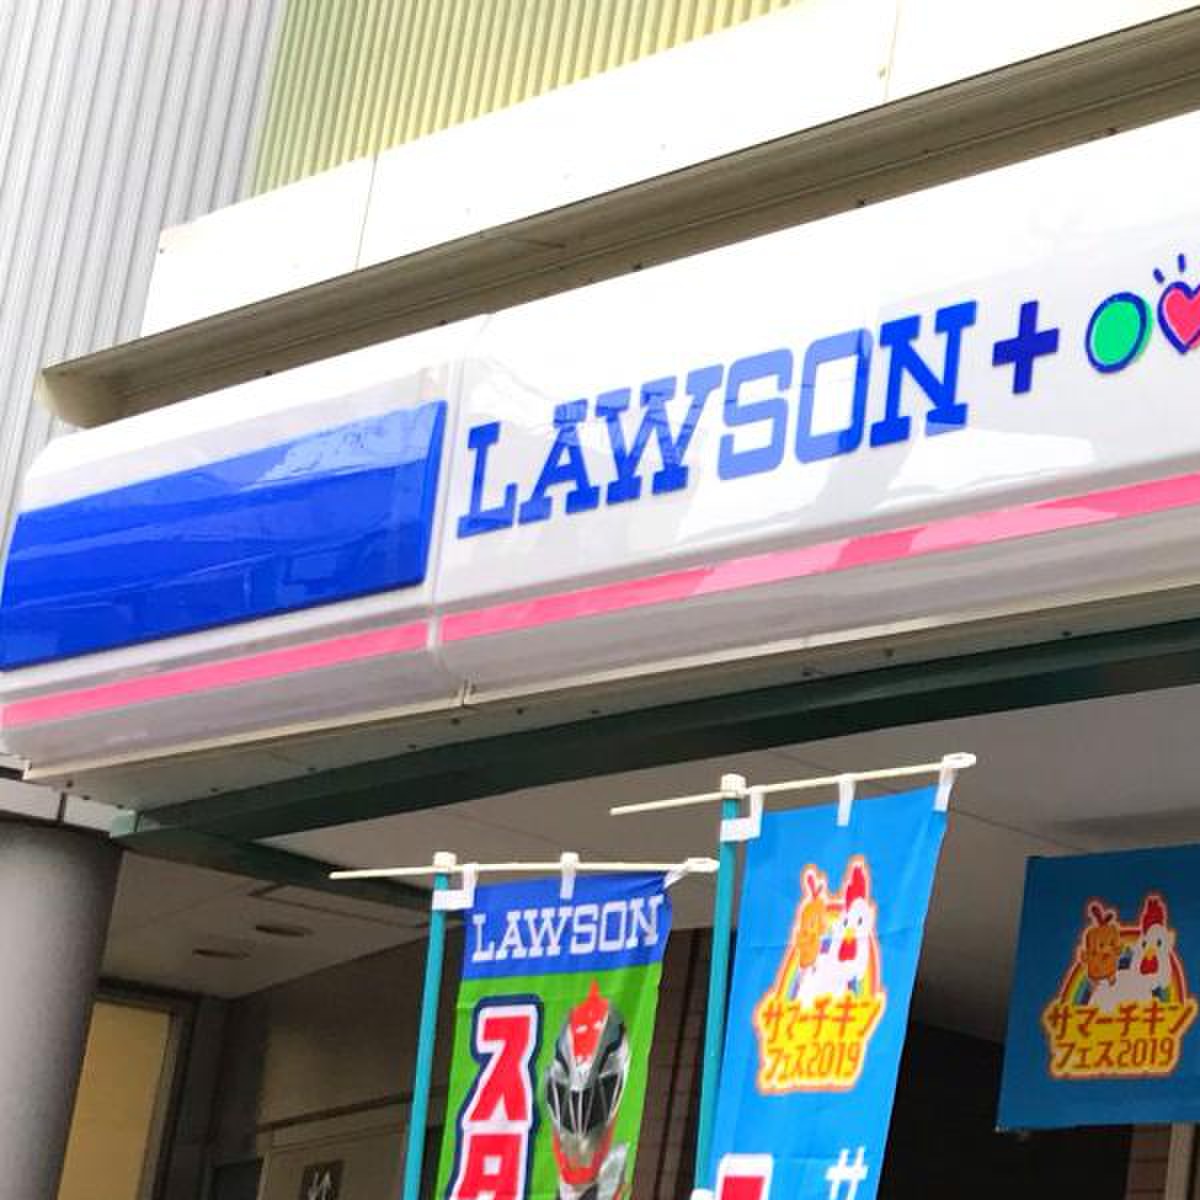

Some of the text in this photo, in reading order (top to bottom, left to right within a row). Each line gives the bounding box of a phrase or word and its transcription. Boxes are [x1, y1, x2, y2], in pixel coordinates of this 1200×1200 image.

[457, 300, 977, 537] LAWSON
[472, 894, 664, 962] LAWSON
[761, 995, 882, 1044] サマーチキン
[1047, 1000, 1194, 1041] サマーチキン
[764, 1040, 862, 1081] フェス2019
[1056, 1036, 1174, 1069] フェス2019
